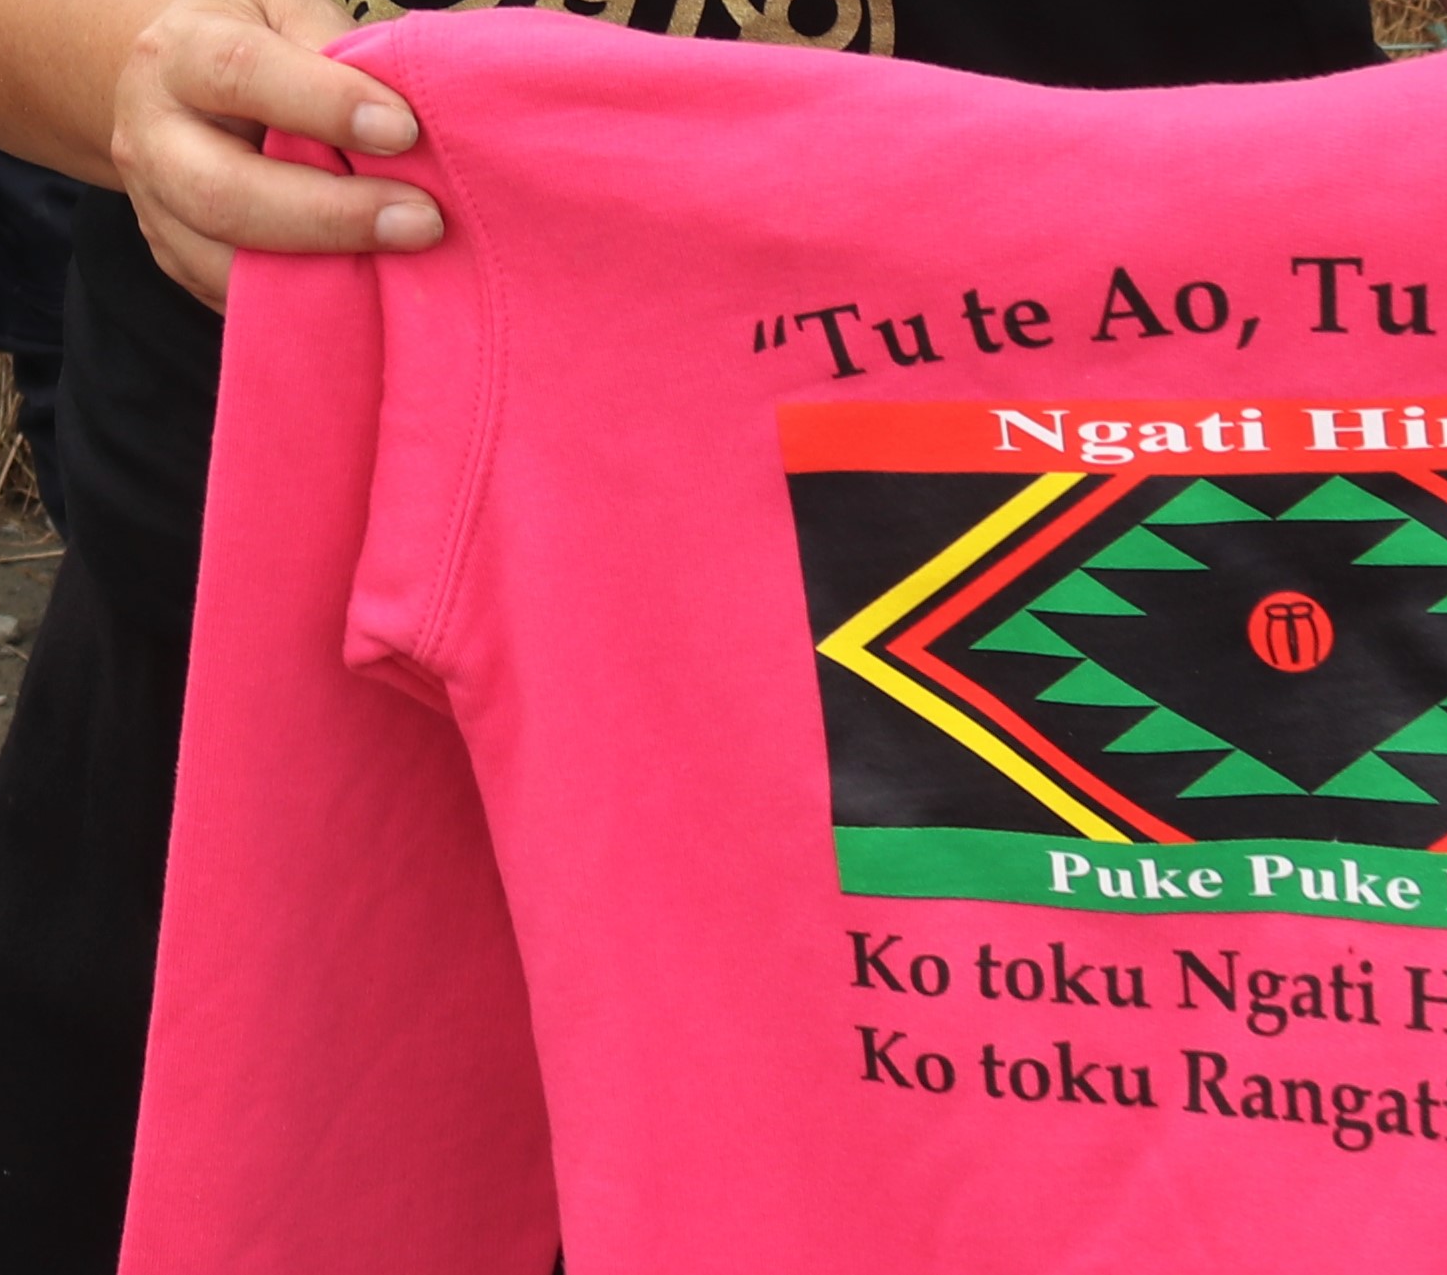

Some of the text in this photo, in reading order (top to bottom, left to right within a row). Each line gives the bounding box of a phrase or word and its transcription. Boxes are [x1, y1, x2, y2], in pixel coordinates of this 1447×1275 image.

[961, 284, 1054, 351] te
[1090, 263, 1263, 352] Ao,
[1291, 256, 1431, 338] Tu
[988, 407, 1270, 464] Ngati
[1046, 850, 1224, 905] Puke
[1246, 853, 1422, 912] Puke
[846, 930, 952, 999] Ko
[976, 942, 1152, 1010] toku
[1173, 948, 1379, 1036] Ngati
[854, 1025, 957, 1095] Ko
[980, 1039, 1158, 1109] toku
